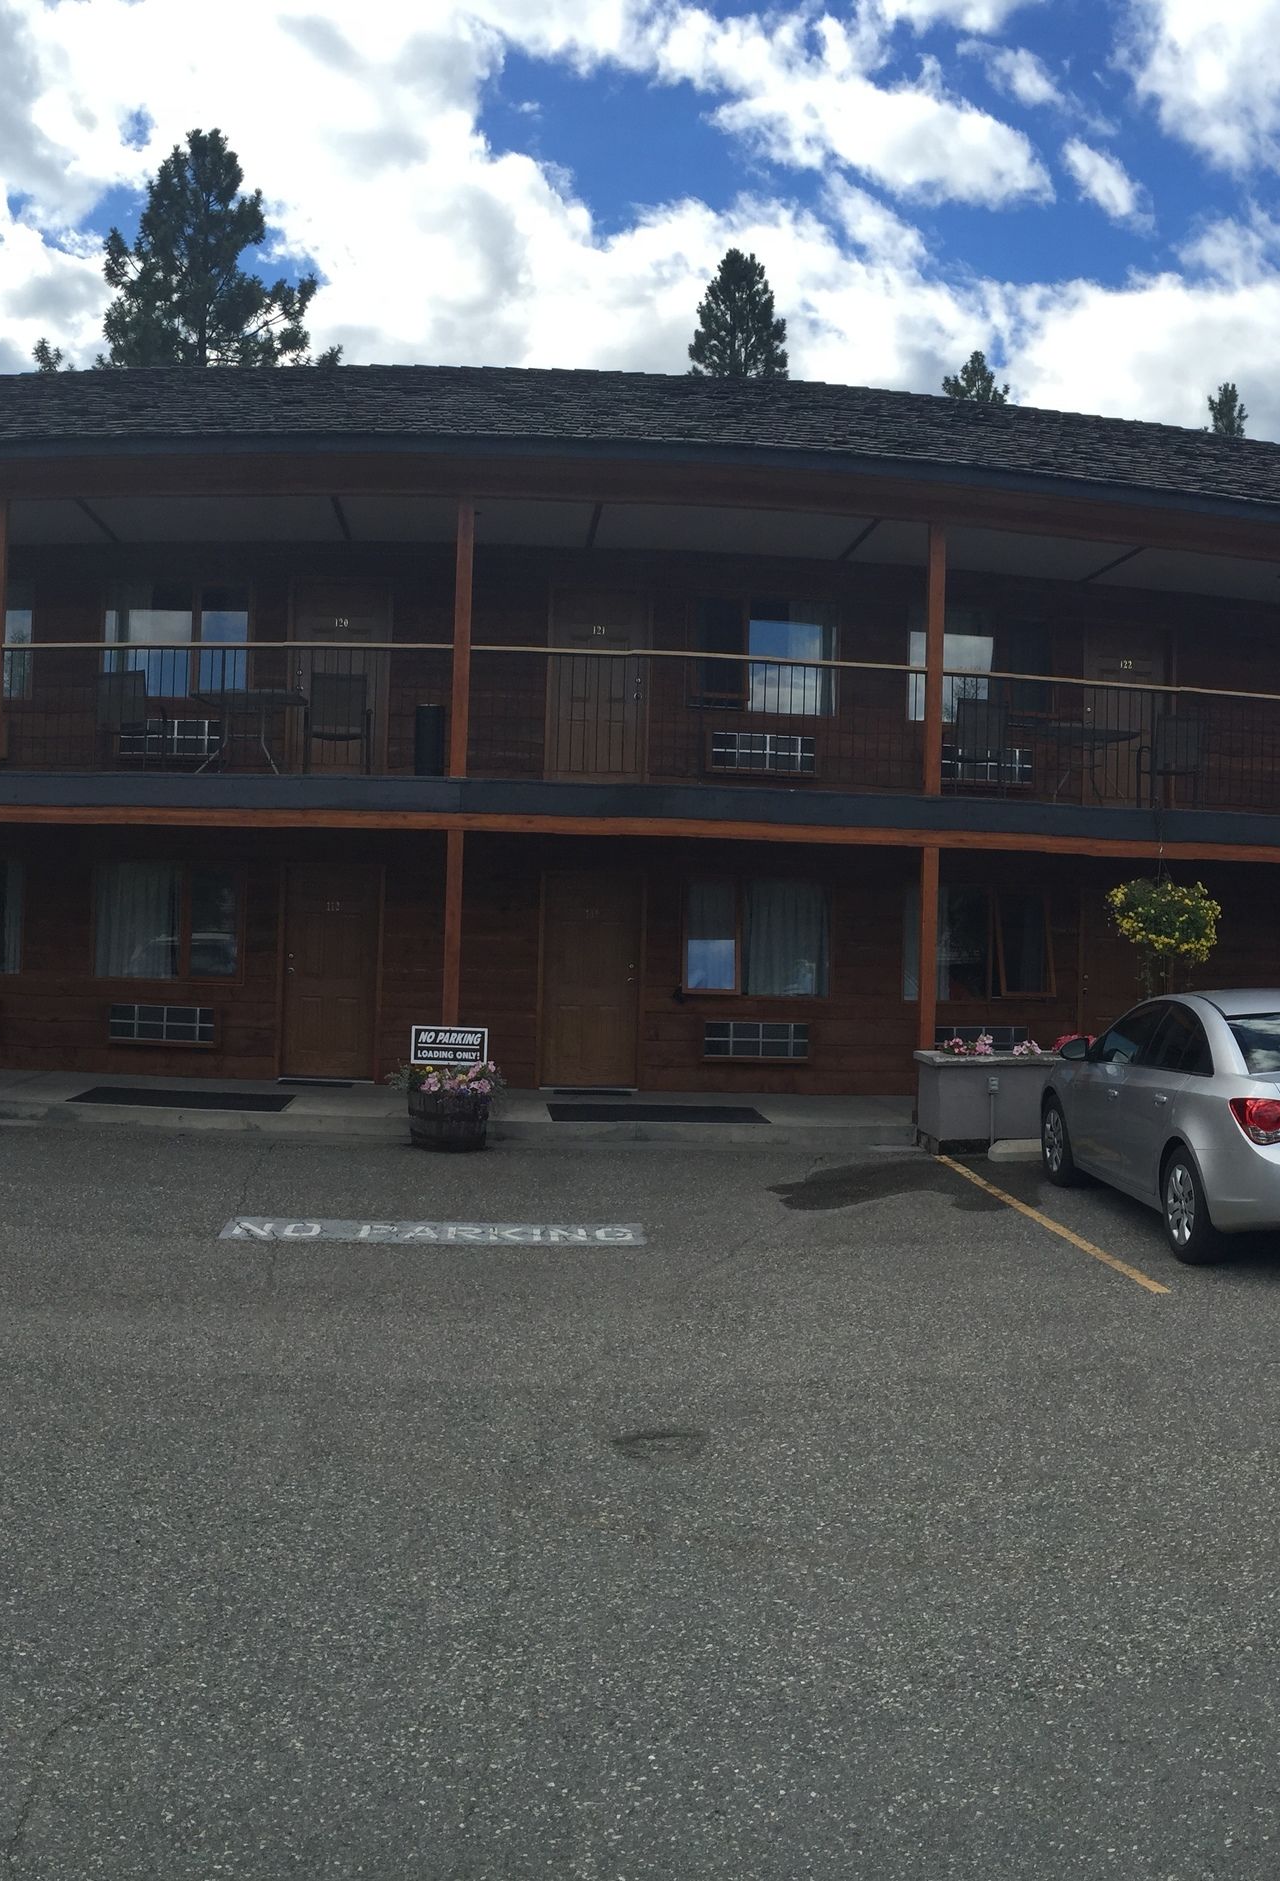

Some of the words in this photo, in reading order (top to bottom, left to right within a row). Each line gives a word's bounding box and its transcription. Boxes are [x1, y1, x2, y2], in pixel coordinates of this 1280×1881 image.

[335, 617, 349, 628] 120
[593, 625, 606, 636] 121
[1120, 660, 1133, 670] 122
[418, 1031, 435, 1043] NO
[436, 1032, 482, 1045] PARKING
[417, 1050, 454, 1059] LOADING
[456, 1051, 480, 1060] ONLY!
[231, 1222, 322, 1236] NO
[358, 1224, 633, 1242] PARKING
